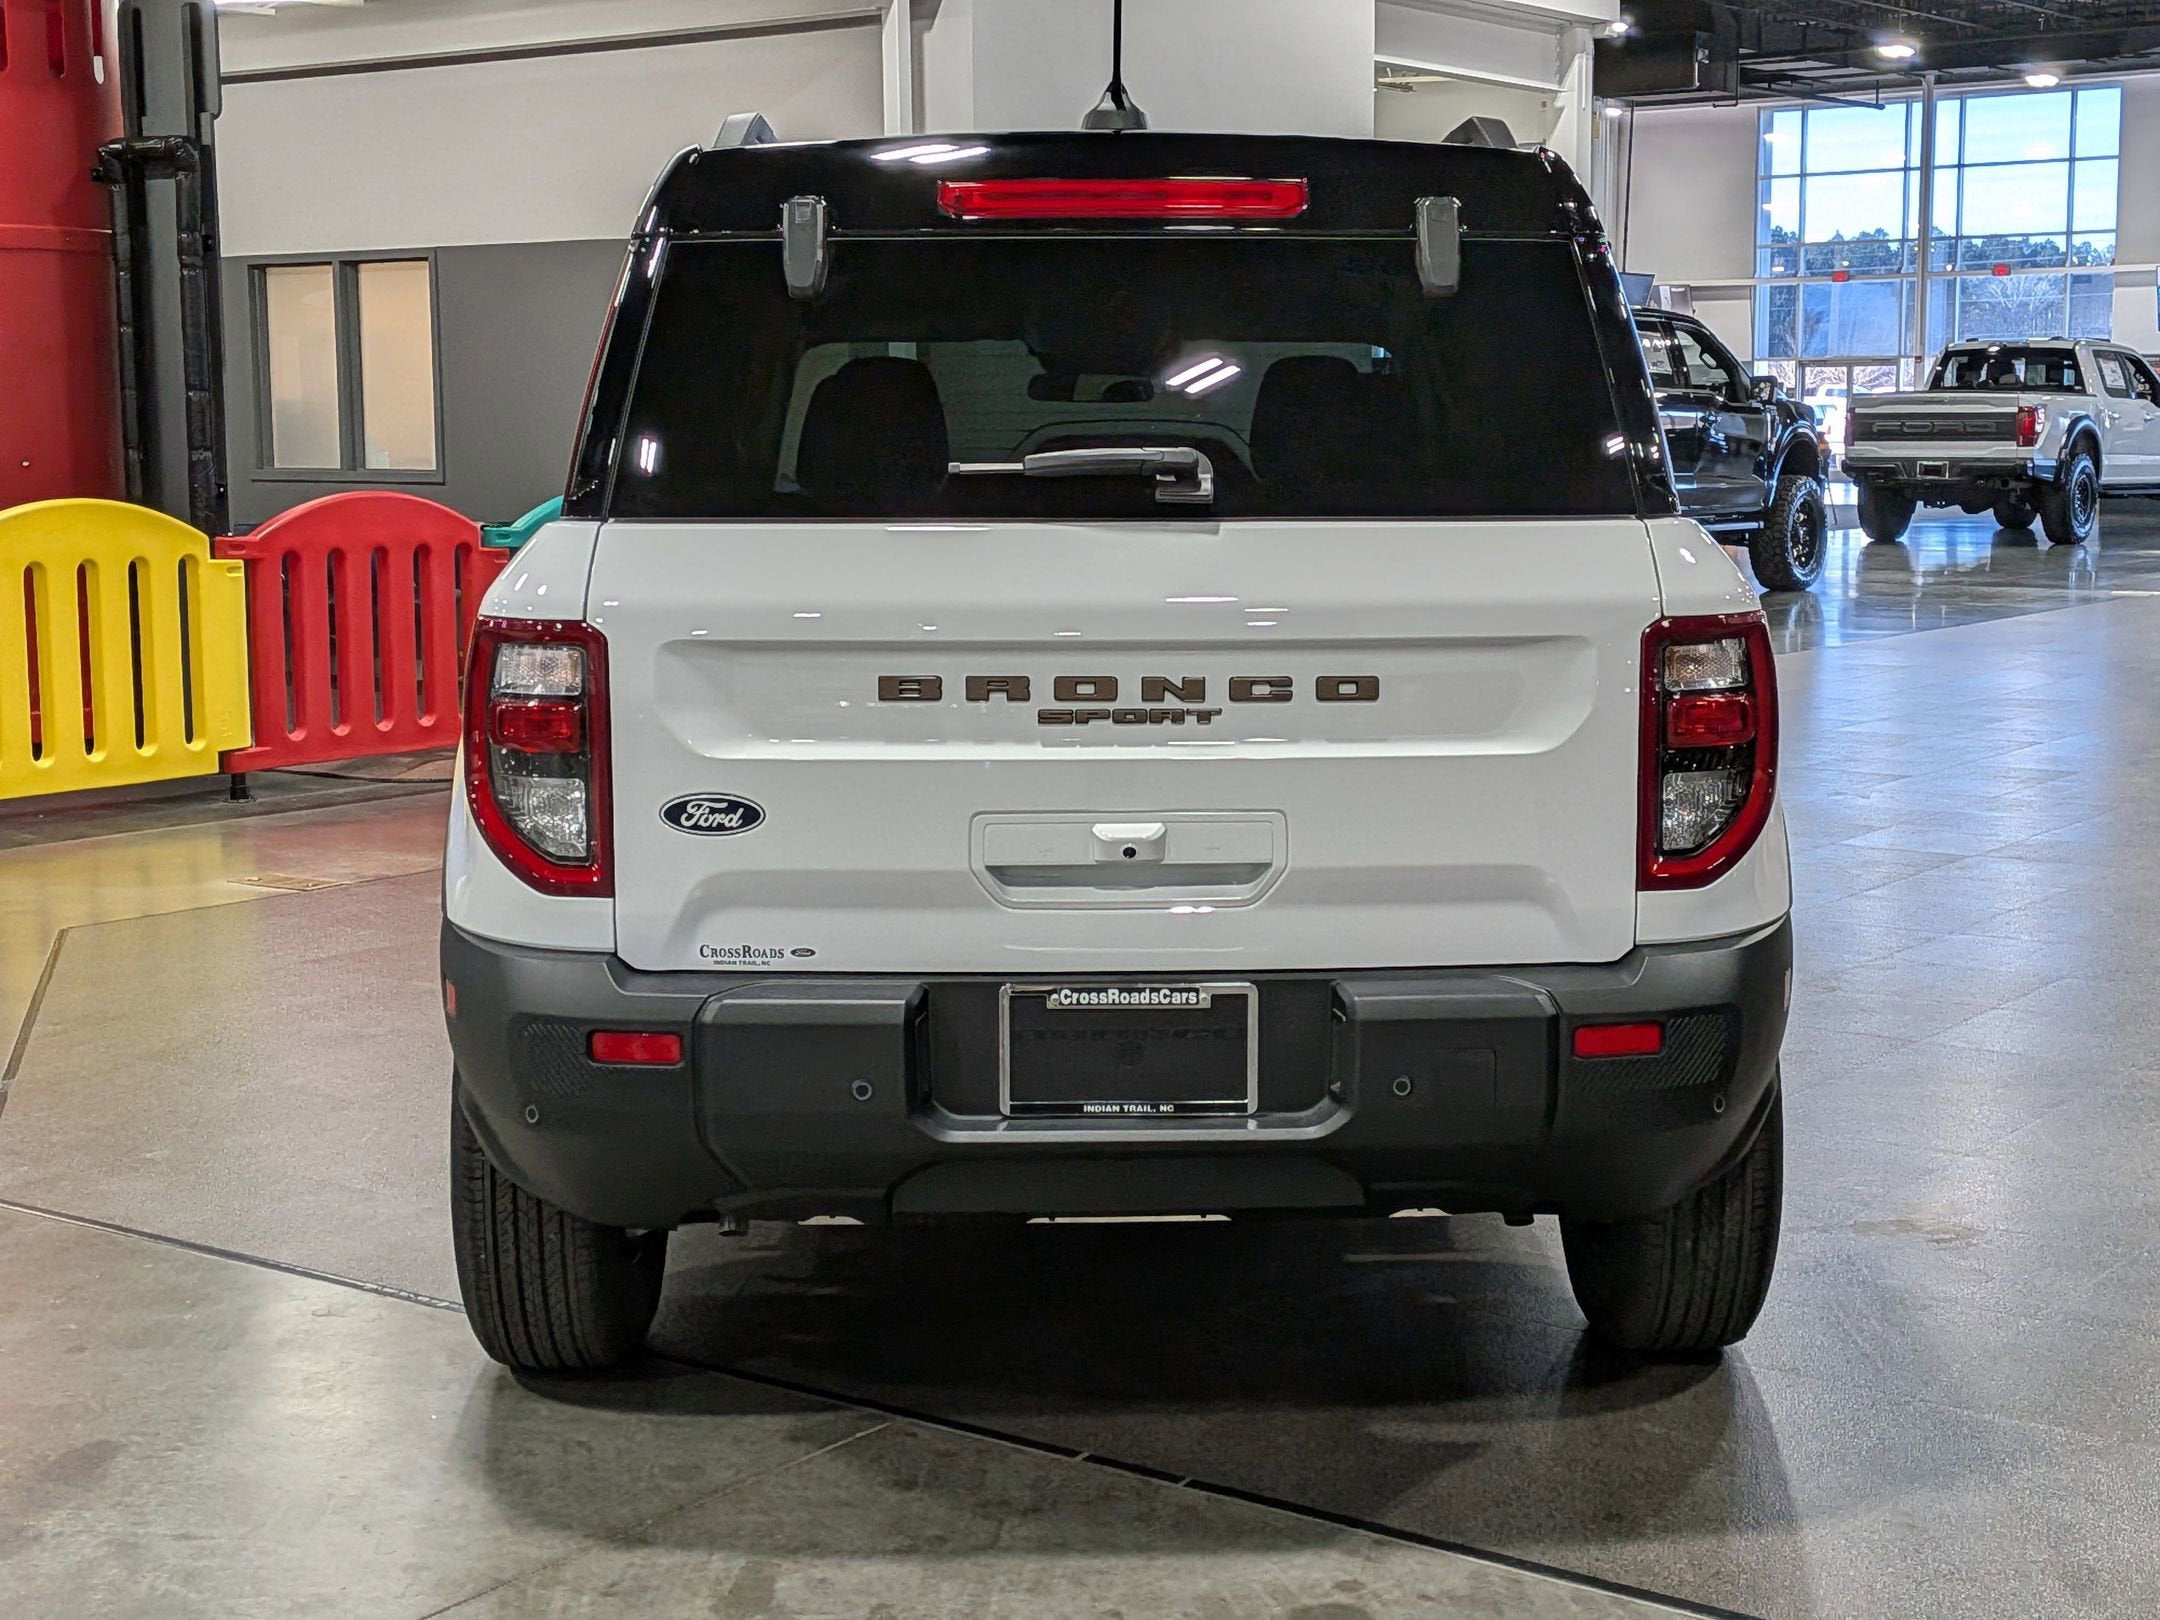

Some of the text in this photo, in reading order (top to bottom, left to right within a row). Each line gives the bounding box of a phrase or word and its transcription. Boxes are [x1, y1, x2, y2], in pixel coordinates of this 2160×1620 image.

[878, 675, 1379, 702] BRONCO
[1037, 708, 1223, 725] SPORT
[680, 801, 745, 828] Ford
[1083, 1104, 1120, 1113] INDIAN
[1159, 1104, 1175, 1113] NC
